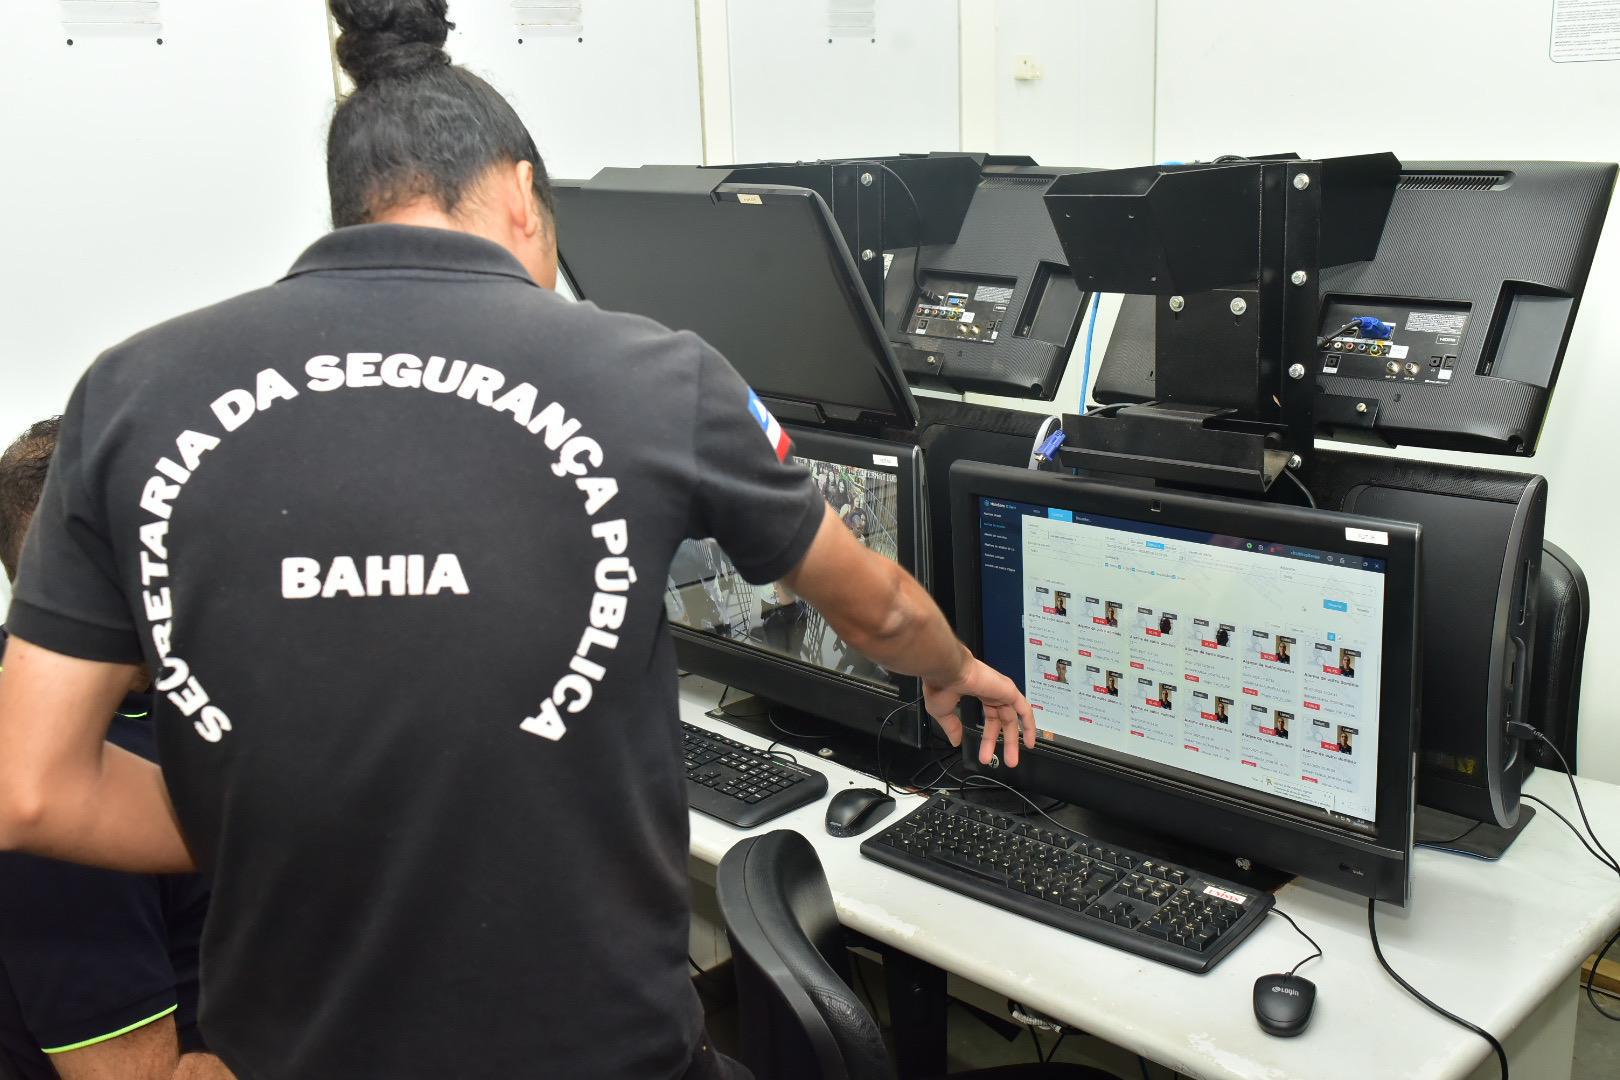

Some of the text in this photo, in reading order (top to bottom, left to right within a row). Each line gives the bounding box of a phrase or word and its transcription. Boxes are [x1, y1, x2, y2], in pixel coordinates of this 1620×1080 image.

[139, 352, 638, 742] SECRETARIA DA SEGURANÇA PÚBLICA
[281, 553, 470, 599] BAHIA
